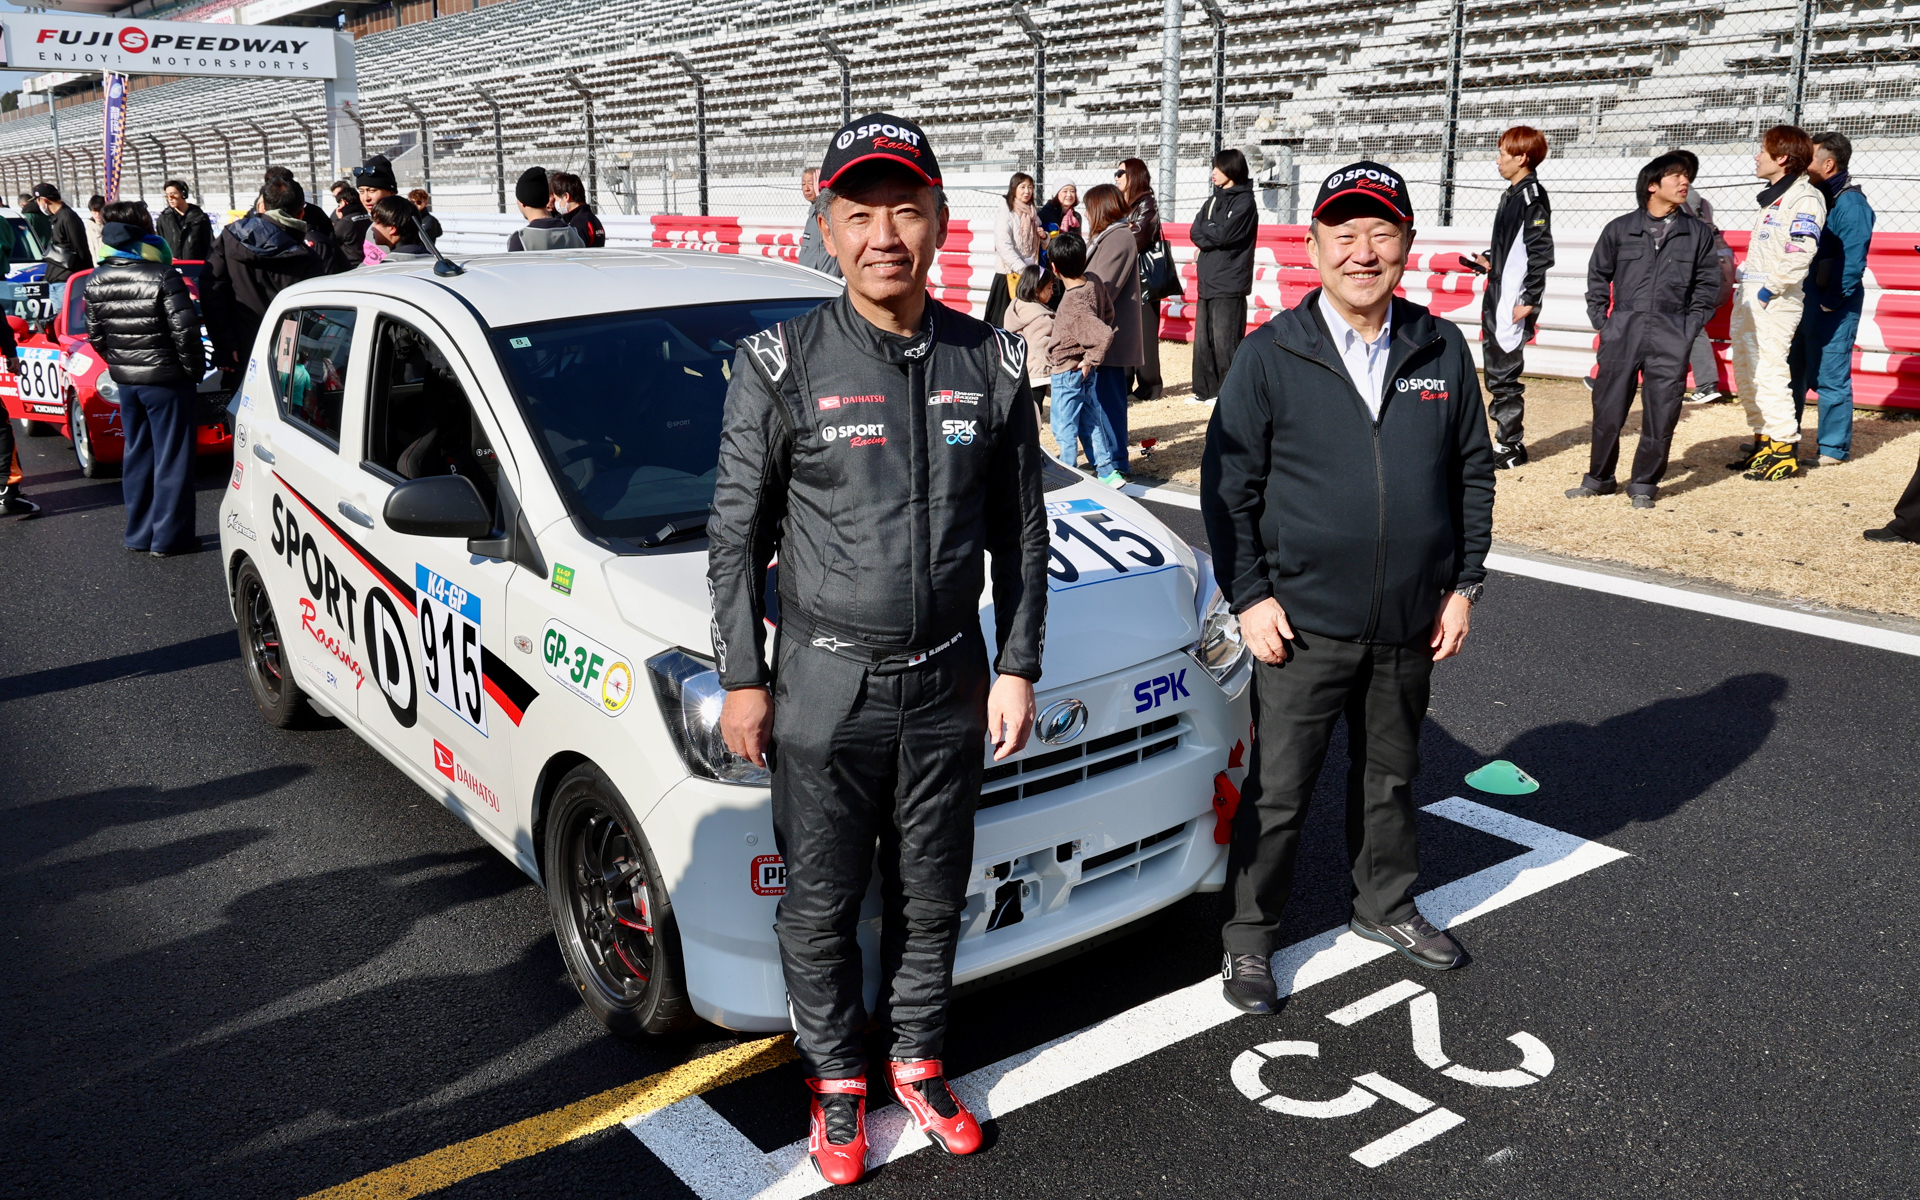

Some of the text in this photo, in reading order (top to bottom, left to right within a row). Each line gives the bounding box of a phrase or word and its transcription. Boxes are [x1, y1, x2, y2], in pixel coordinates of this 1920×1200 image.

[38, 51, 310, 70] ENJOY! MOTORSPORTS
[856, 123, 921, 146] SPORT
[872, 136, 922, 158] Racing
[1344, 168, 1399, 189] SPORT
[1356, 178, 1400, 198] Racing
[14, 298, 54, 320] 497
[20, 359, 60, 400] 880
[1409, 378, 1446, 391] SPORT
[842, 395, 885, 404] DAIHATSU
[1420, 390, 1449, 401] Racing
[33, 404, 66, 415] YOKOHAMA
[838, 424, 885, 438] SPORT
[941, 420, 978, 435] SPK
[850, 436, 887, 448] Racing
[271, 493, 357, 645] SPORT
[426, 571, 468, 613] K4-GP
[299, 597, 366, 690] Racing
[420, 598, 482, 725] 915
[543, 628, 605, 689] GP-3F
[1133, 668, 1191, 714] SPK
[456, 763, 500, 812] DAIHATSU
